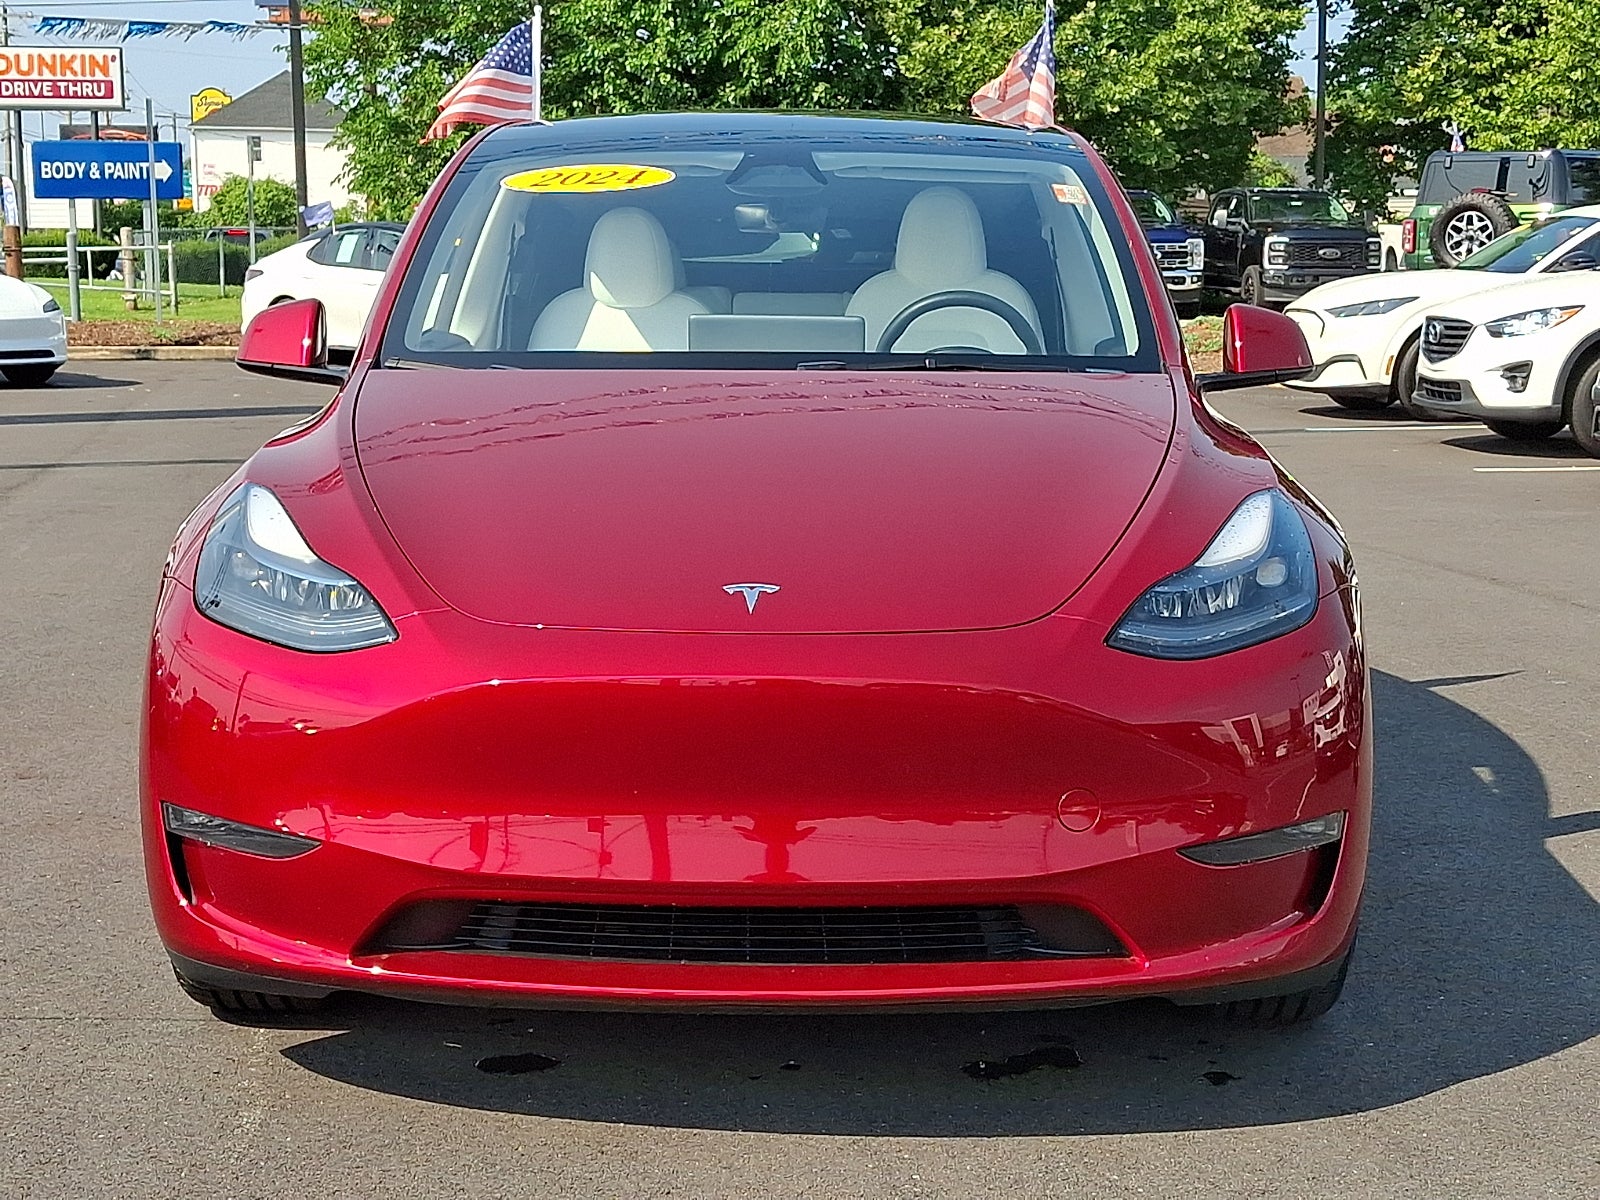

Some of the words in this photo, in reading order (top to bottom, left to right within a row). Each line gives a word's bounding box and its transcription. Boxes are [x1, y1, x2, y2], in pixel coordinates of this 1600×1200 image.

[1, 81, 54, 97] DRIVE
[57, 81, 106, 97] THRU
[40, 161, 86, 179] BODY
[89, 161, 100, 180] &
[104, 161, 150, 180] PAINT
[530, 170, 647, 187] 2024
